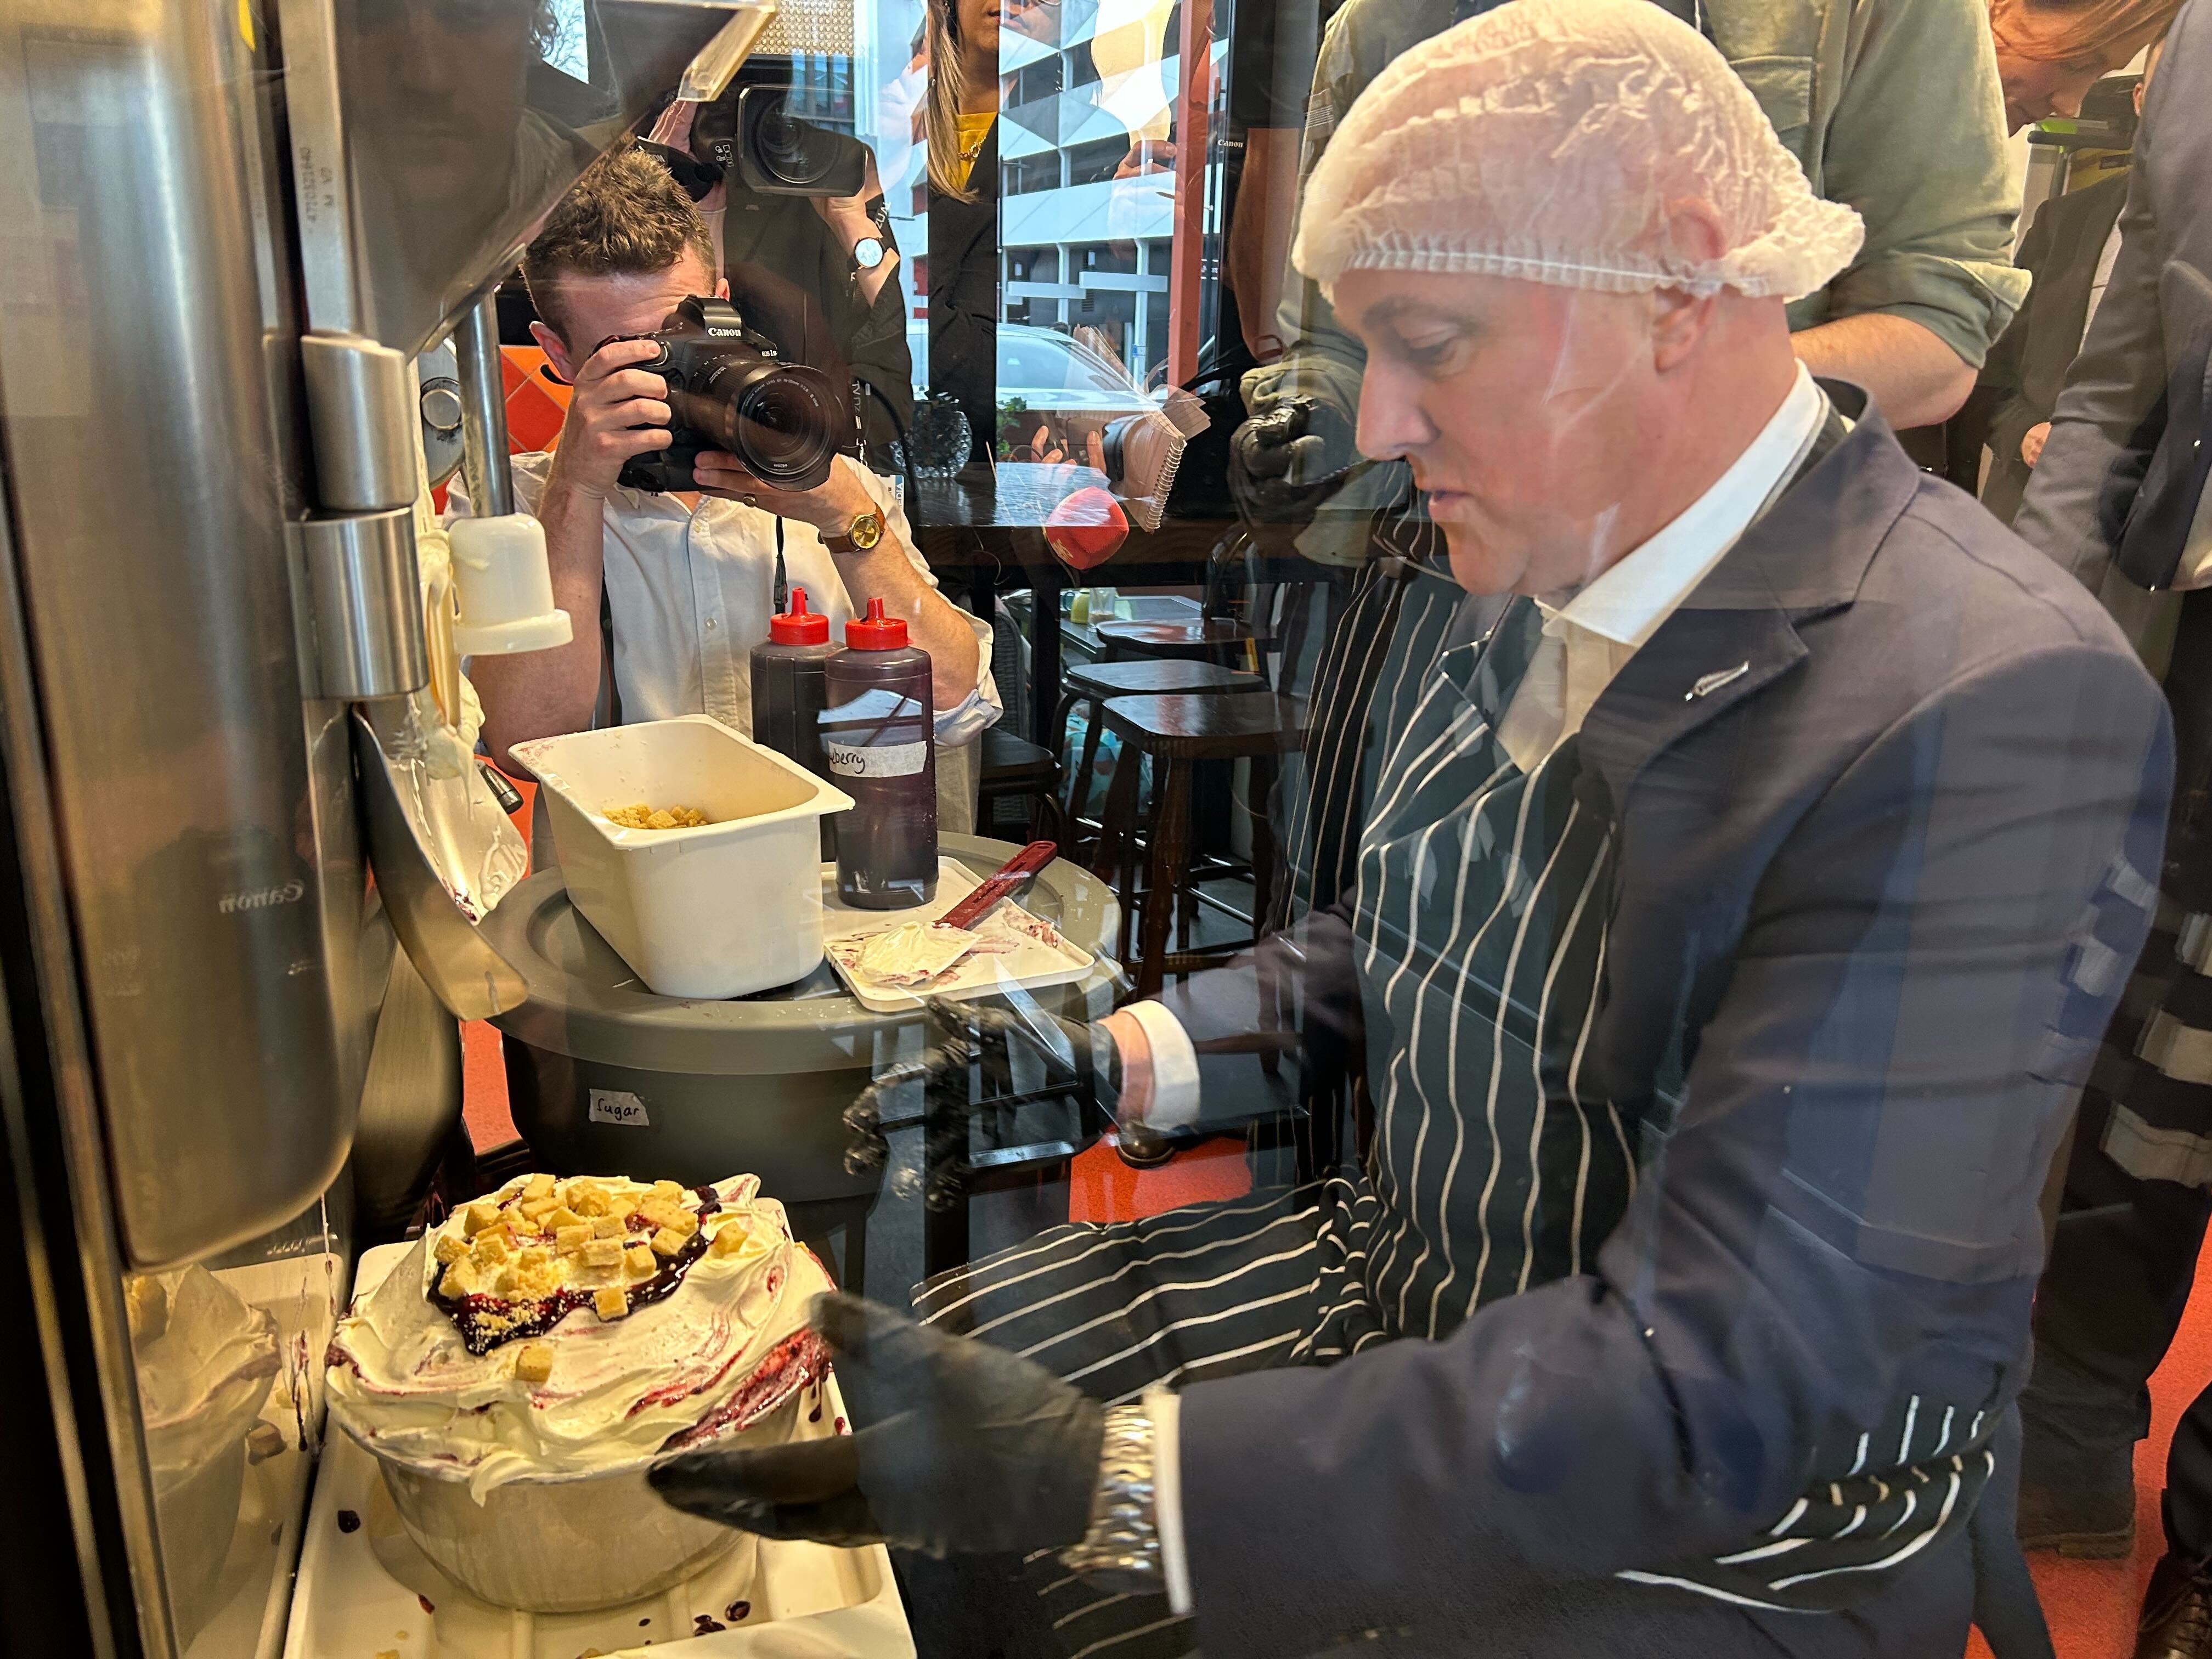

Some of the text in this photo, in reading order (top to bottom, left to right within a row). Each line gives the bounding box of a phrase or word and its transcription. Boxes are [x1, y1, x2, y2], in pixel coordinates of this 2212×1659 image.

[1217, 139, 1243, 148] Canon
[708, 327, 742, 337] Canon
[597, 1098, 639, 1121] Sugar
